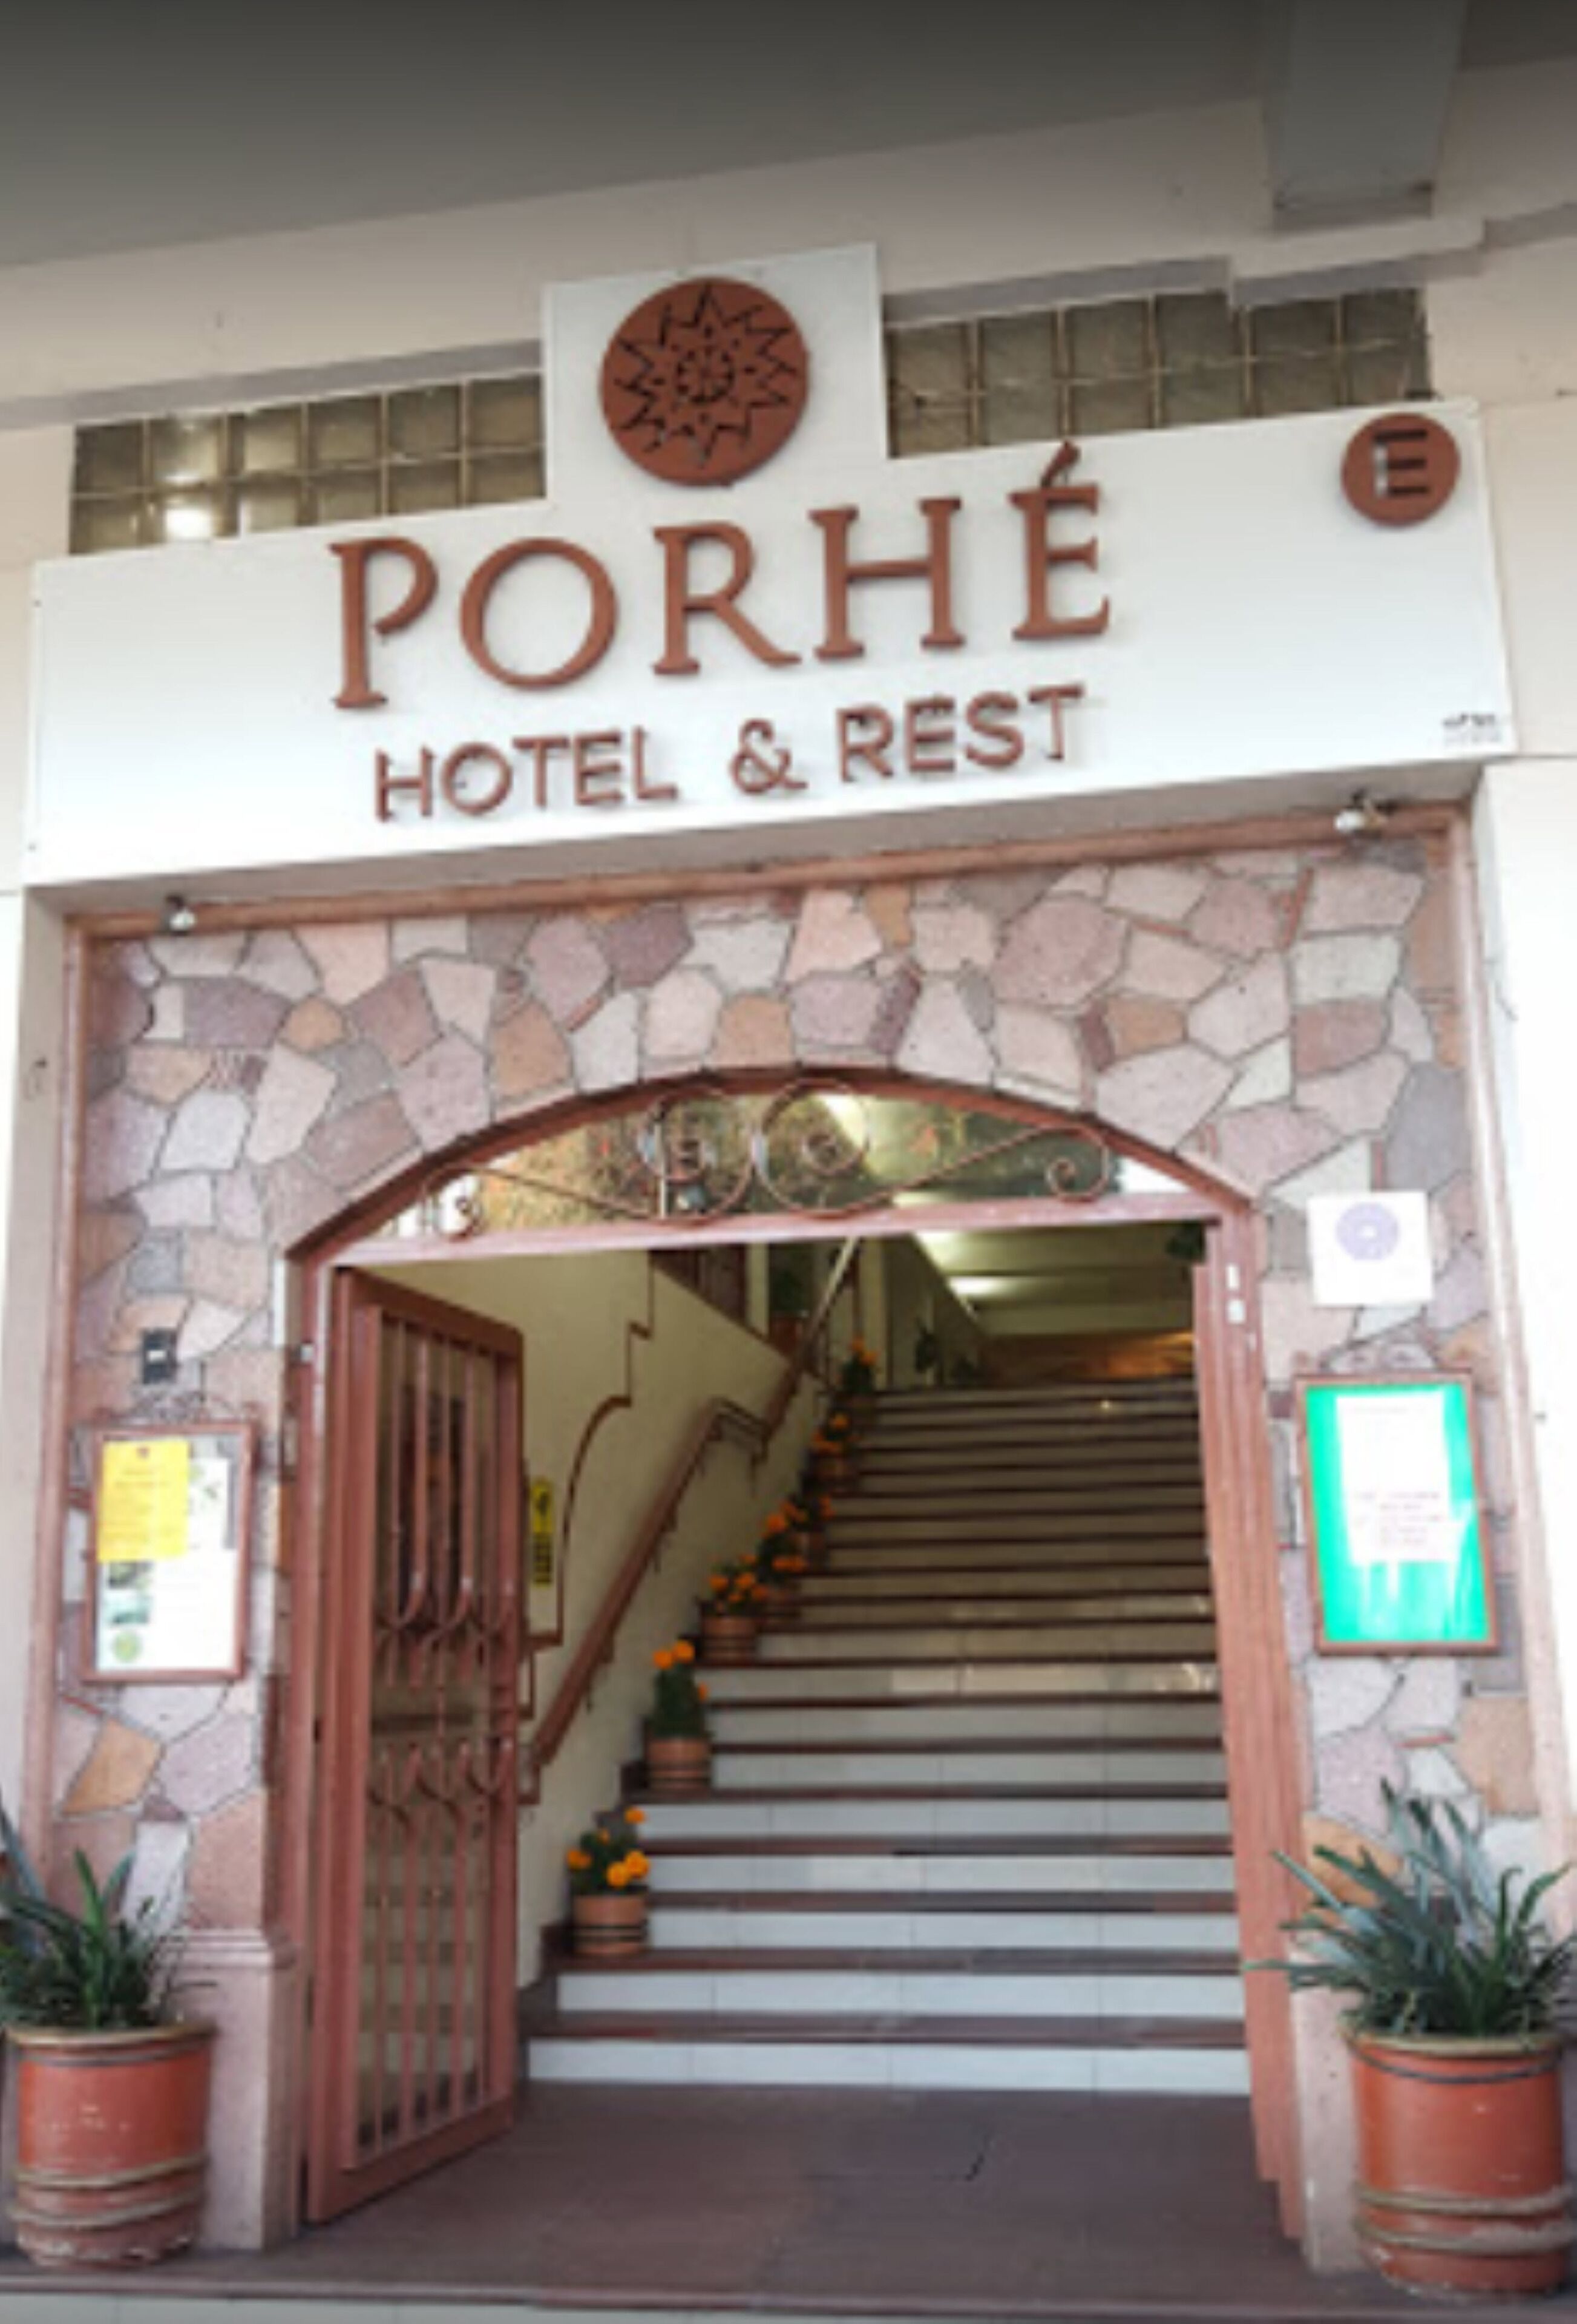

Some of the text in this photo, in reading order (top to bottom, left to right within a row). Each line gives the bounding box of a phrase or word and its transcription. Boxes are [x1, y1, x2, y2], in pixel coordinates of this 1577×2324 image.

[1372, 428, 1429, 498] E
[329, 442, 1111, 710] PORHÉ
[375, 684, 1085, 822] HOTEL & REST
